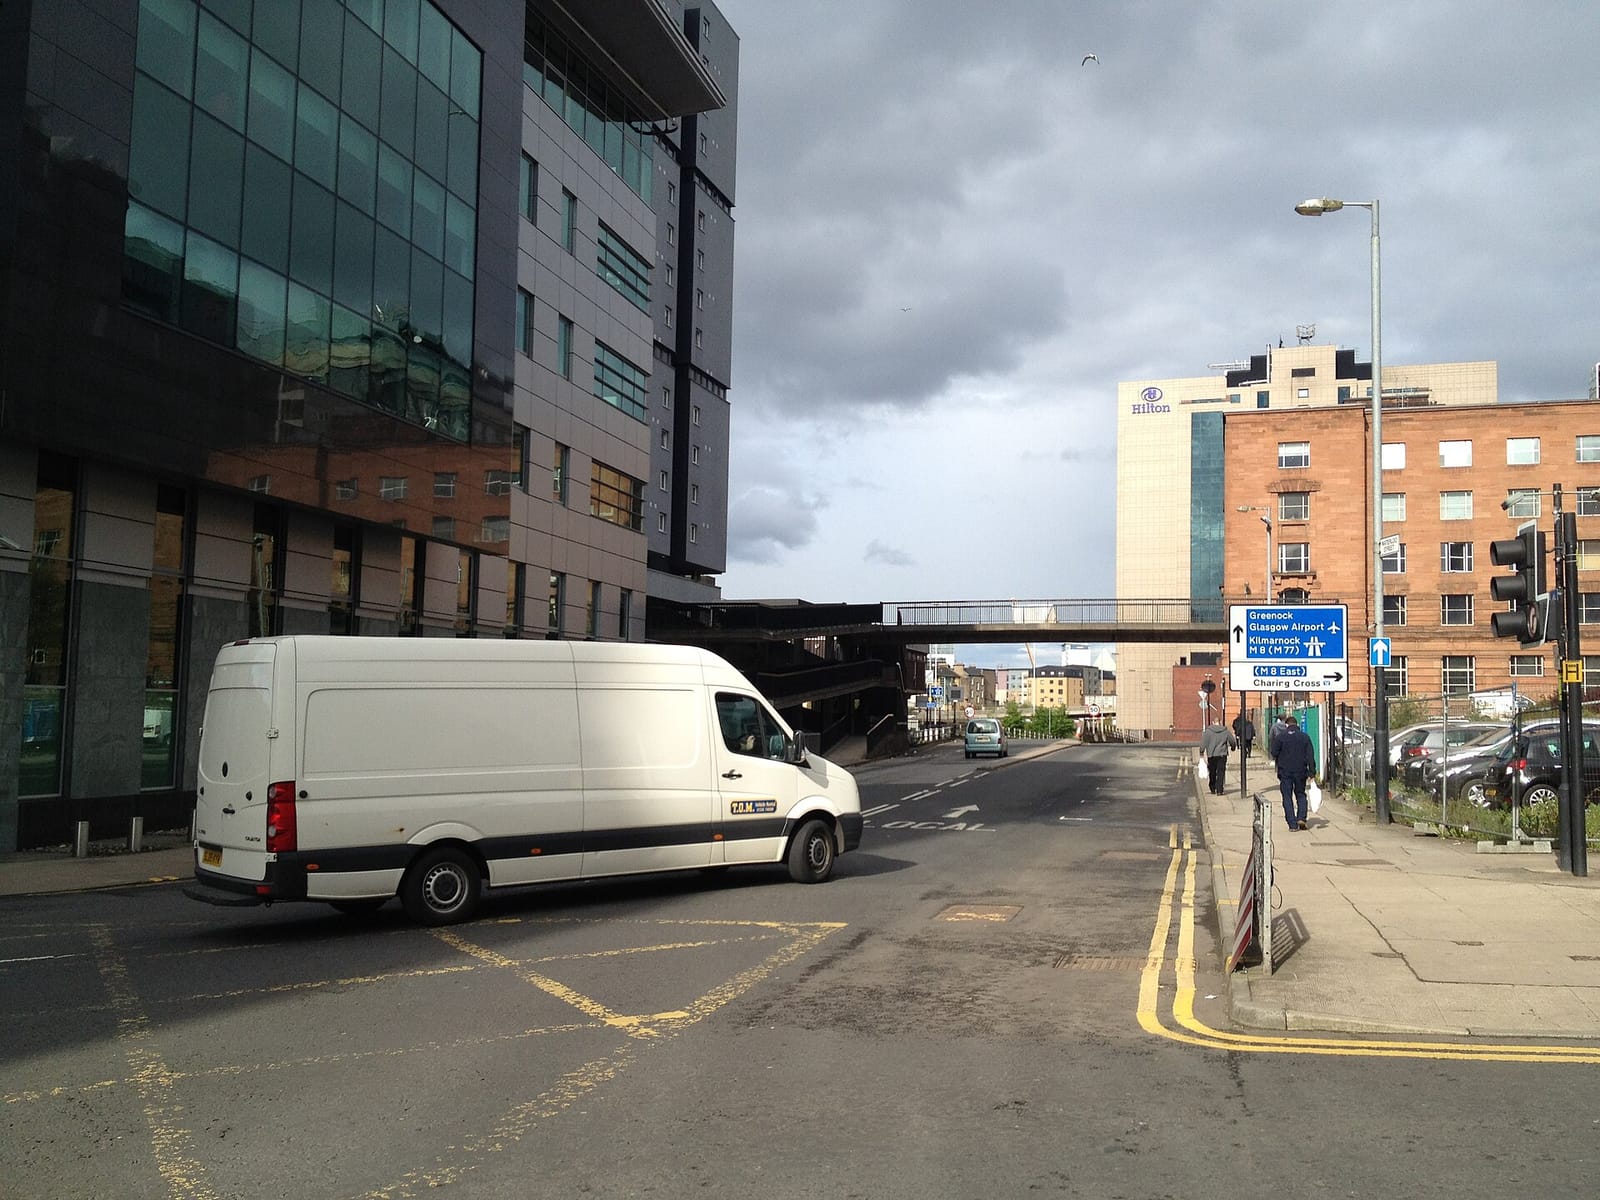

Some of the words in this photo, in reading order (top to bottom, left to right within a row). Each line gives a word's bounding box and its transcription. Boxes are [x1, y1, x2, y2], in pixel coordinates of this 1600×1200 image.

[1132, 403, 1170, 414] Hilton
[1249, 611, 1293, 620] Greenock
[1249, 623, 1289, 632] Glasgow
[1291, 623, 1324, 632] Airport
[1249, 636, 1300, 645] Kilmarnock
[1280, 666, 1306, 676] East)
[1565, 663, 1579, 680] H
[1253, 679, 1290, 688] Charing
[1293, 679, 1320, 687] Cross
